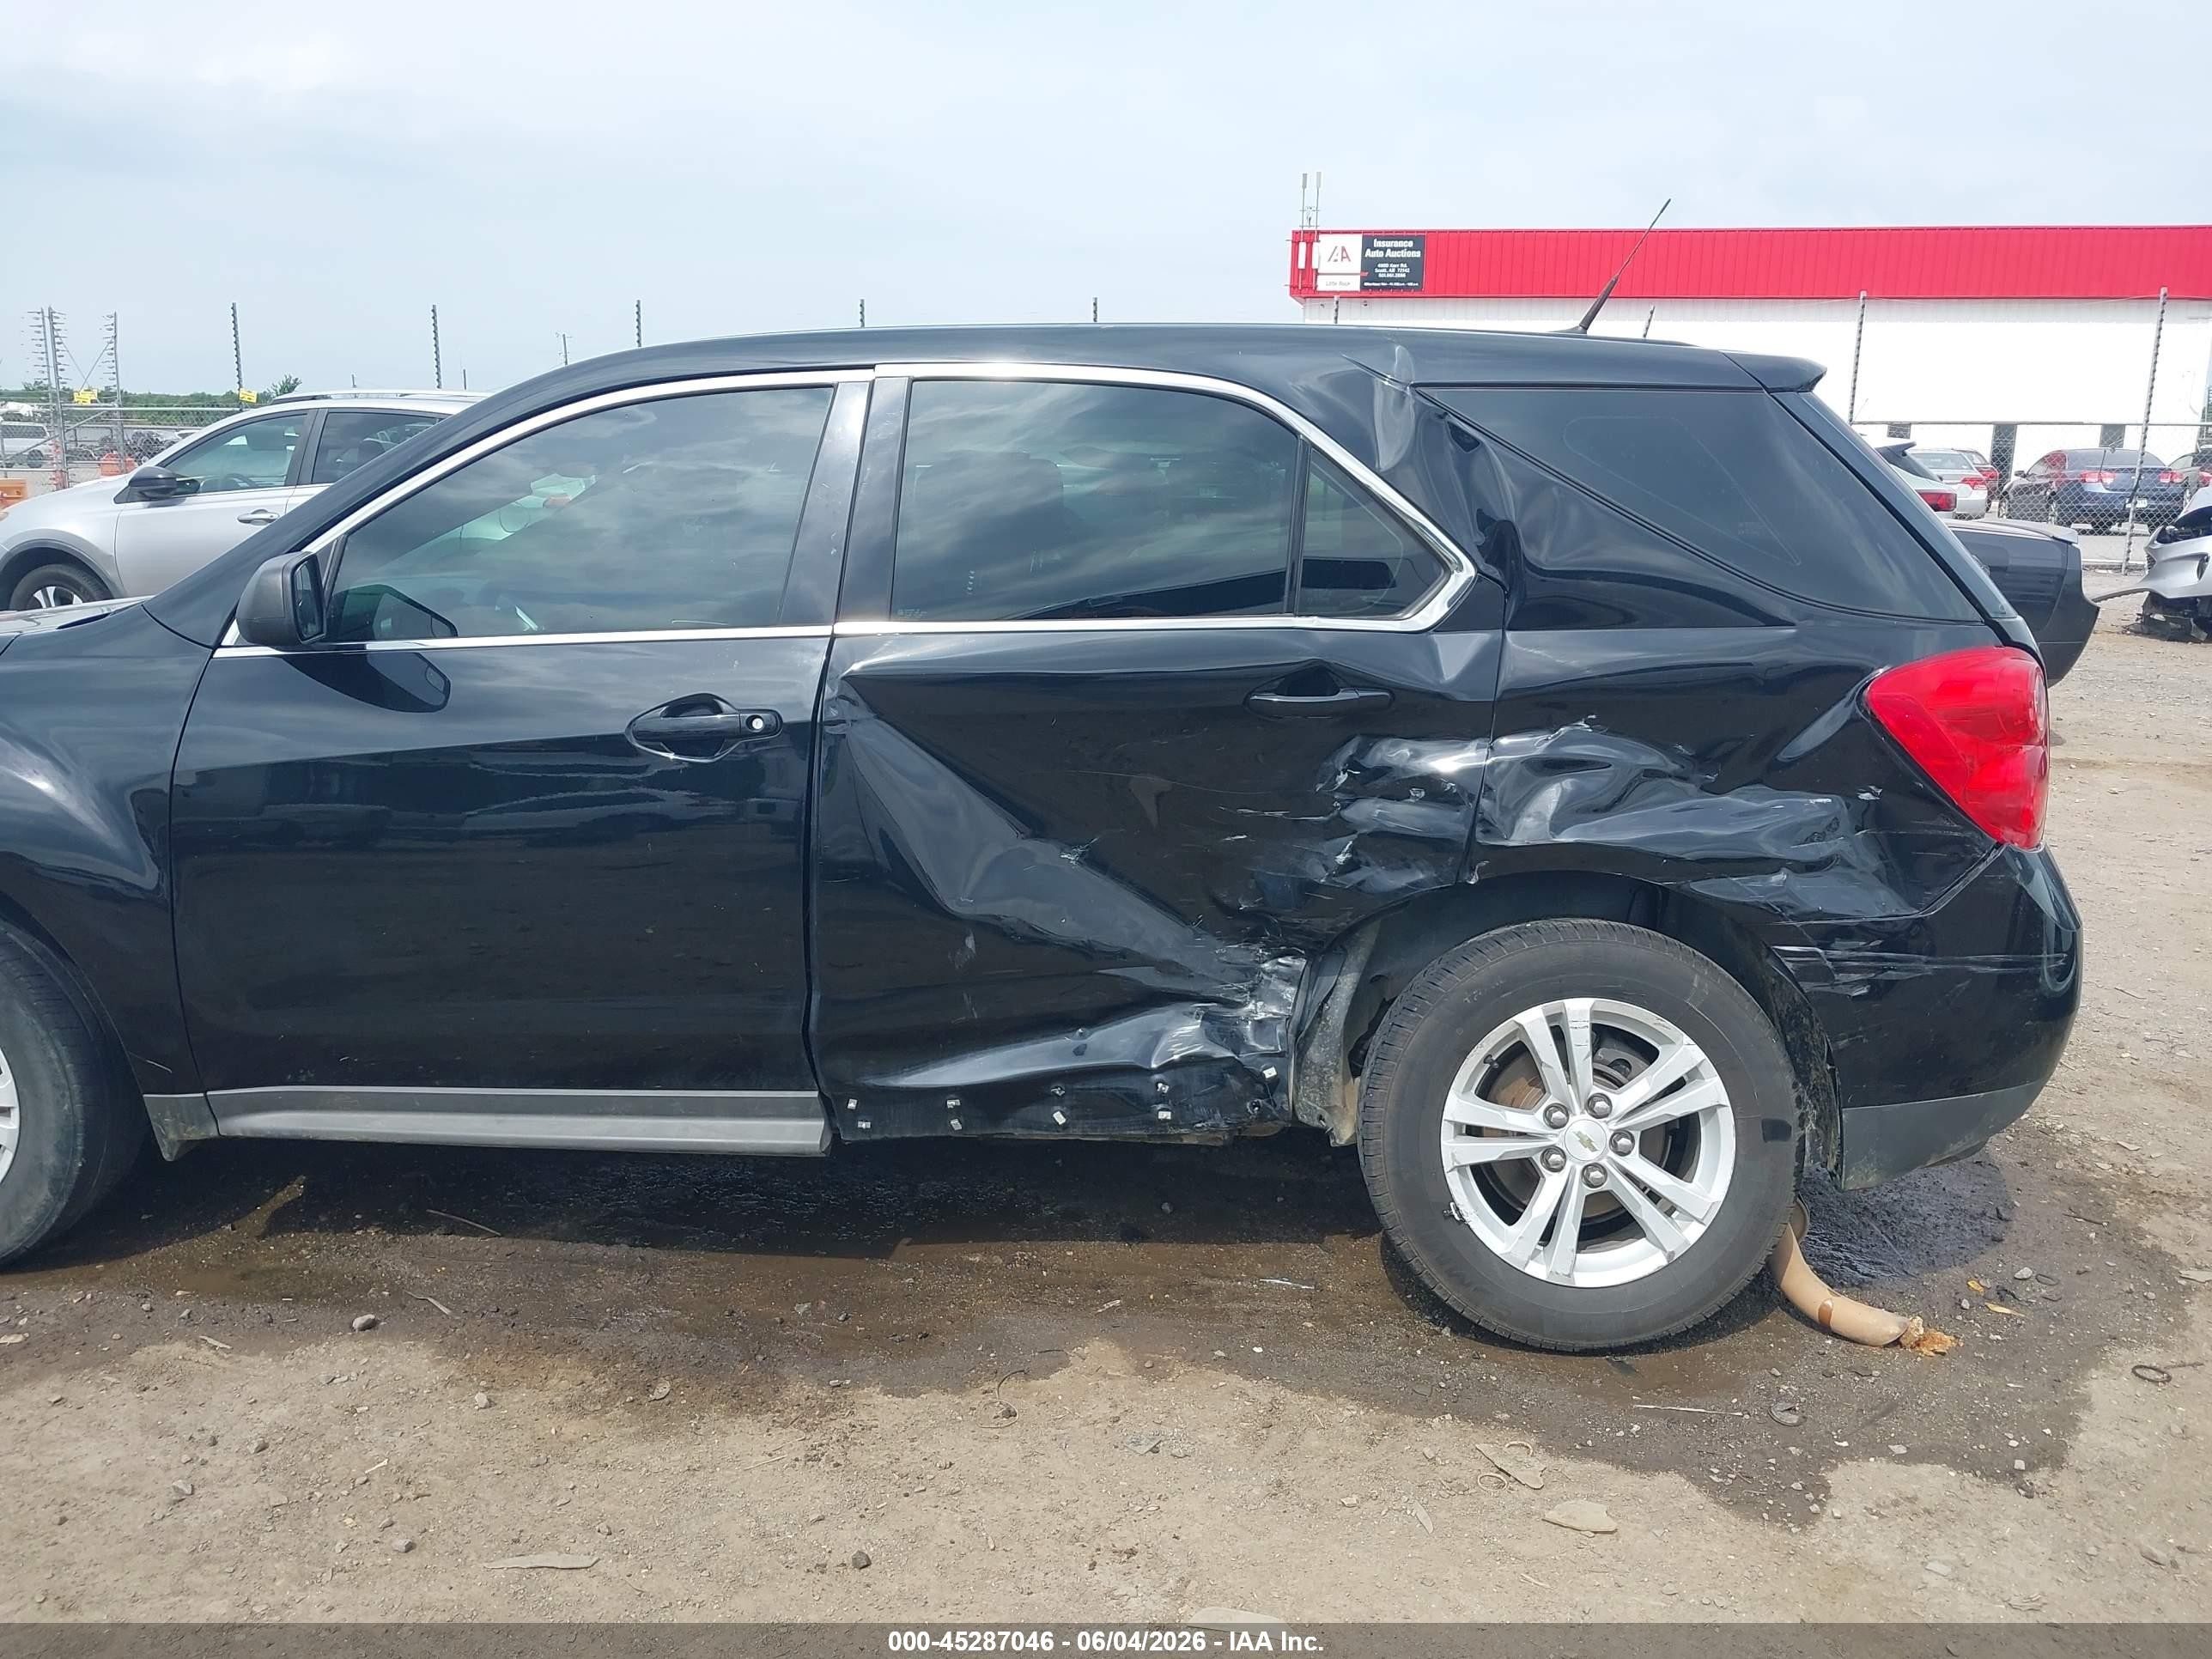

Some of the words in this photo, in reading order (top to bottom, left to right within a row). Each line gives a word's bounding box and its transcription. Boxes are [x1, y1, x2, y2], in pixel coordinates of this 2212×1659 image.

[1373, 238, 1413, 247] Insurance
[1364, 248, 1384, 258] Auto
[1385, 248, 1421, 258] Auctions
